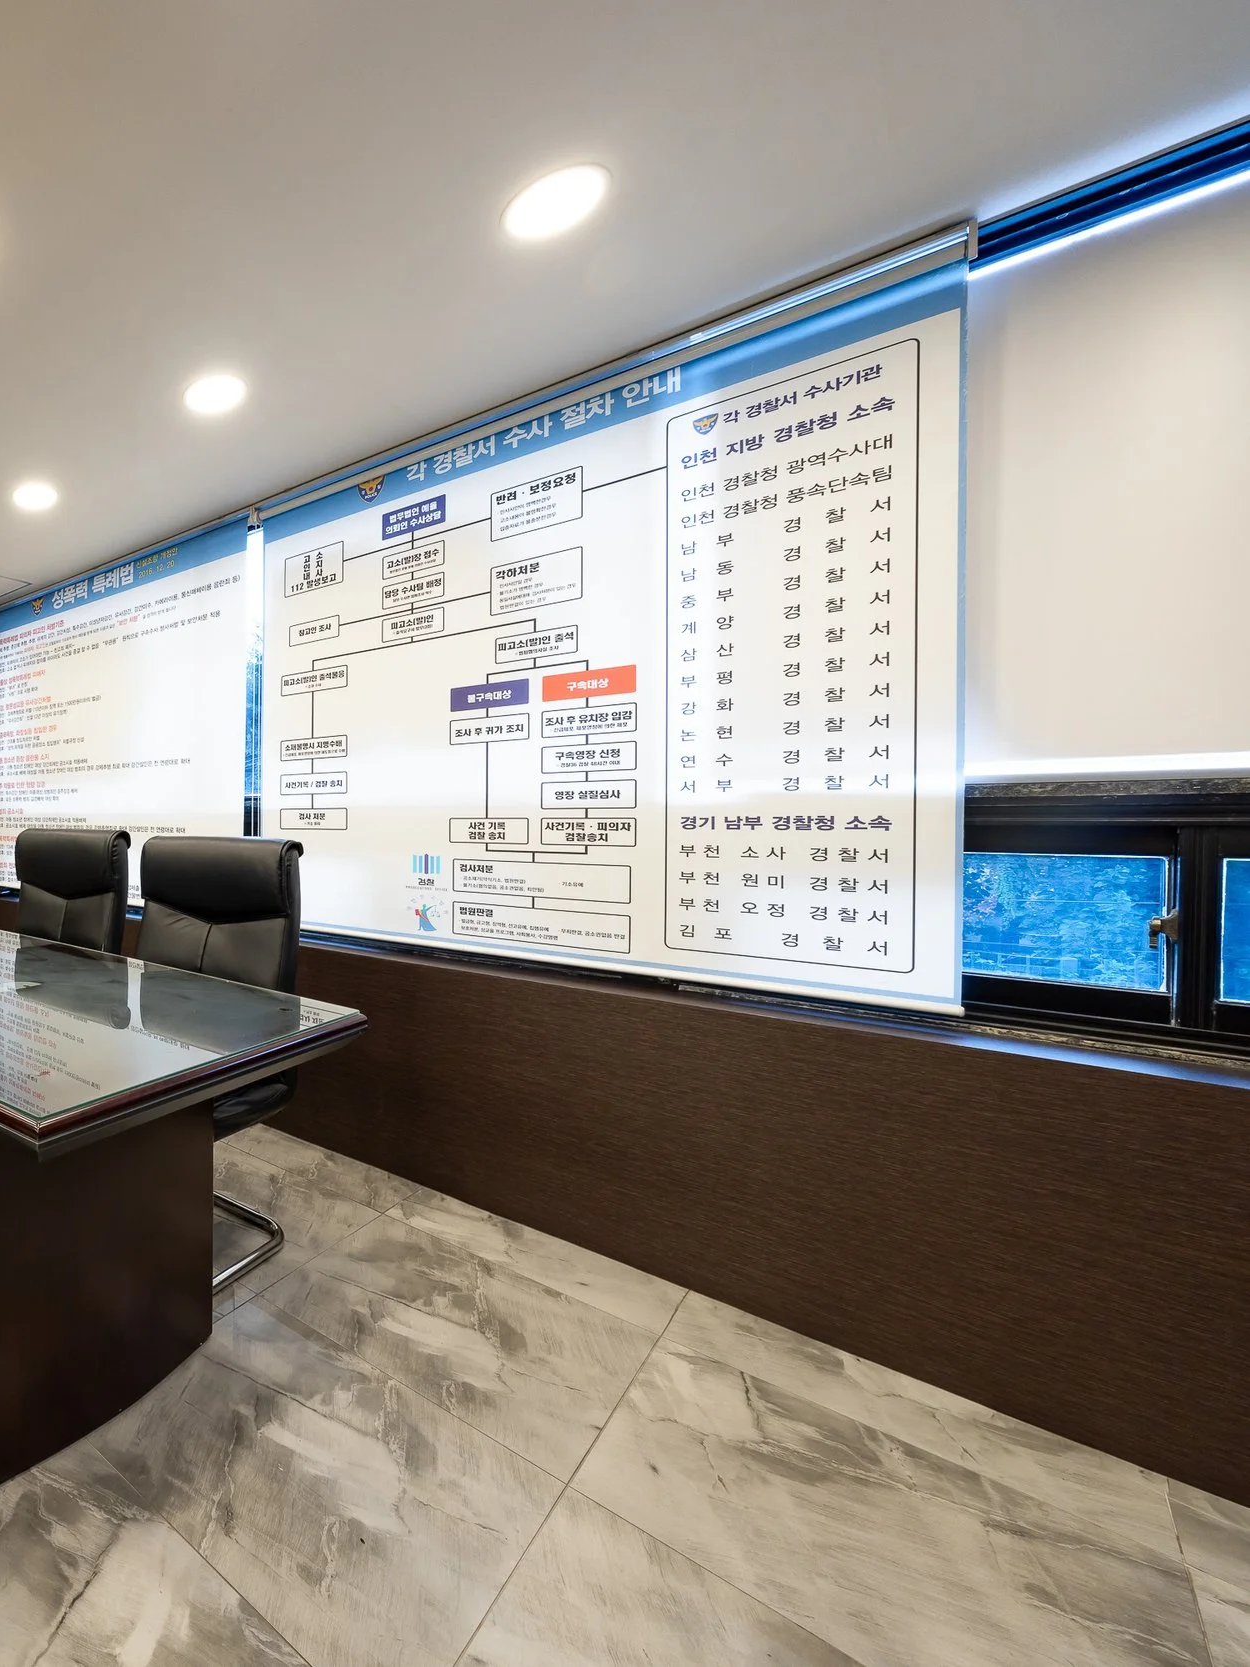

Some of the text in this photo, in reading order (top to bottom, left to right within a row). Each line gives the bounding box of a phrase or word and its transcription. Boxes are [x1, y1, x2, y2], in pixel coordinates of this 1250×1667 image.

[722, 363, 883, 424] 각 경찰서 수사기관
[406, 365, 682, 482] 각 경찰서 수사 절차 안내
[680, 394, 896, 470] 인천 지방 경찰청 소속
[680, 433, 894, 502] 인천 경찰청 광역수사대
[495, 490, 517, 506] 반려
[680, 465, 894, 529] 인천 경찰청 풍속단속팀
[495, 562, 540, 580] 각하처분
[51, 562, 135, 609] 성폭력 특례법
[290, 573, 337, 593] 112 발생보고
[384, 588, 400, 600] 담당
[318, 622, 332, 633] 조사
[566, 677, 609, 692] 구속대상
[467, 688, 512, 704] 불구속대상
[545, 709, 633, 727] 조사 후 유치장 입감
[454, 723, 524, 738] 조사 후 귀가 조치
[555, 749, 597, 760] 구속영장
[554, 789, 621, 800] 영장 실질심사
[468, 821, 506, 831] 사건 기록
[544, 821, 632, 832] 사건기록 피의자
[680, 815, 893, 831] 경기 남부 경찰청 소속
[468, 831, 506, 841] 검찰 송치
[565, 832, 609, 843] 검찰송치
[459, 863, 494, 874] 검사처분
[459, 906, 494, 918] 법원판결
